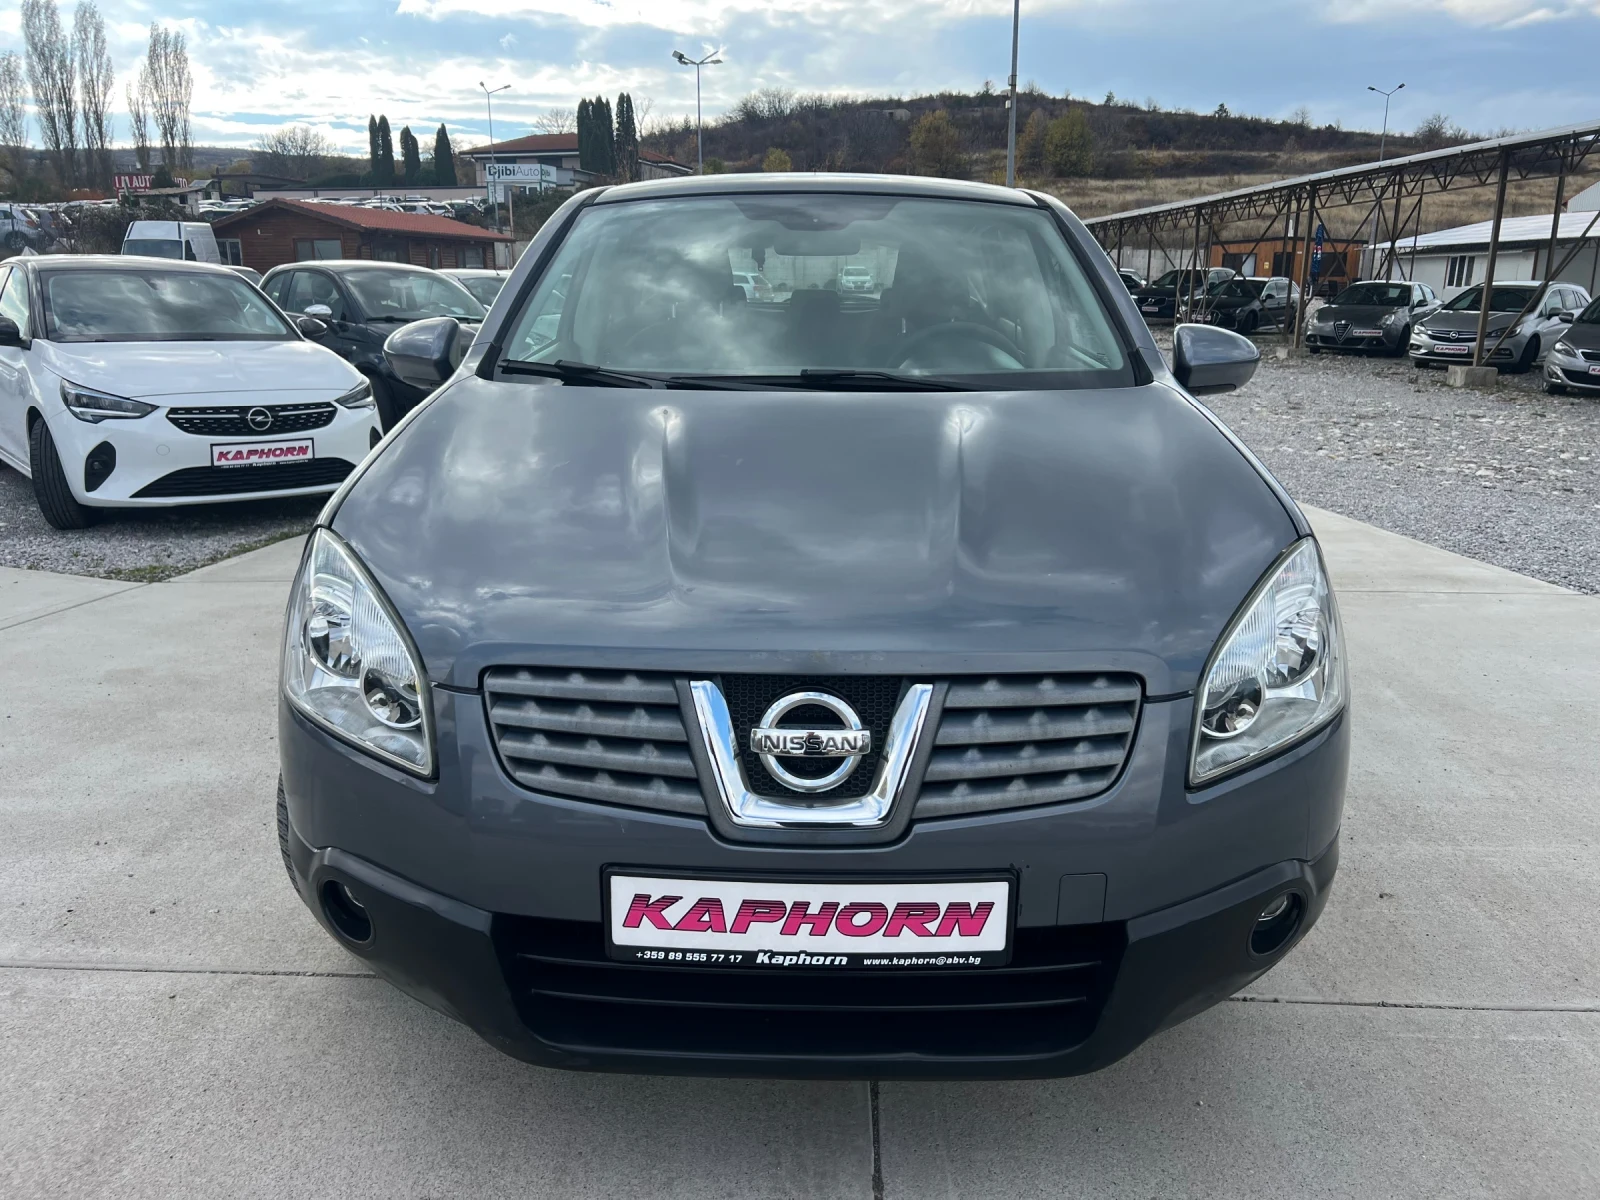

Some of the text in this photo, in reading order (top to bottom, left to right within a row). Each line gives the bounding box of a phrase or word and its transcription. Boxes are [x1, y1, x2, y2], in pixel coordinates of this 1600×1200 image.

[217, 446, 309, 462] KAPHORN
[763, 734, 858, 752] NISSAN
[622, 893, 996, 937] KAPHORN
[635, 950, 981, 967] +359 89 555 77 17 Kaphorn www.kaphorn@abv.bg
